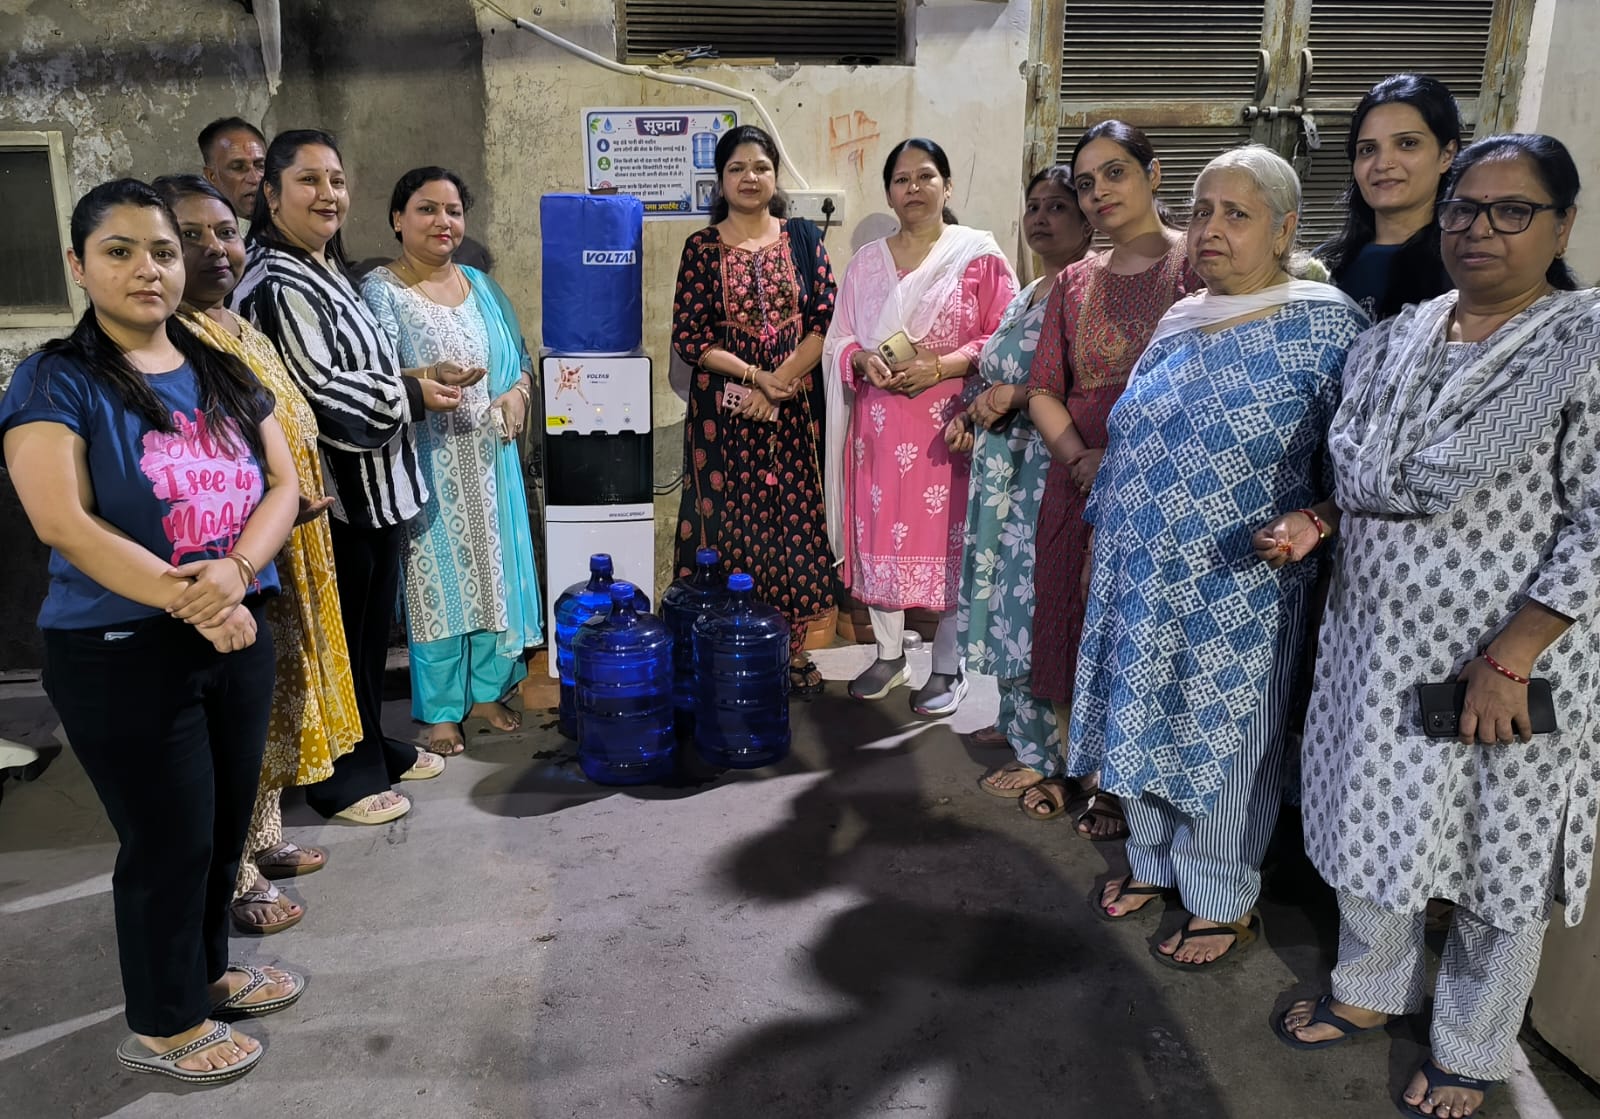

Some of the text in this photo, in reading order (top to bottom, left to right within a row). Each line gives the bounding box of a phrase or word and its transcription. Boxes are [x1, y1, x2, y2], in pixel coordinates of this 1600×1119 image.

[643, 119, 681, 135] सूचना
[160, 462, 255, 503] I see is
